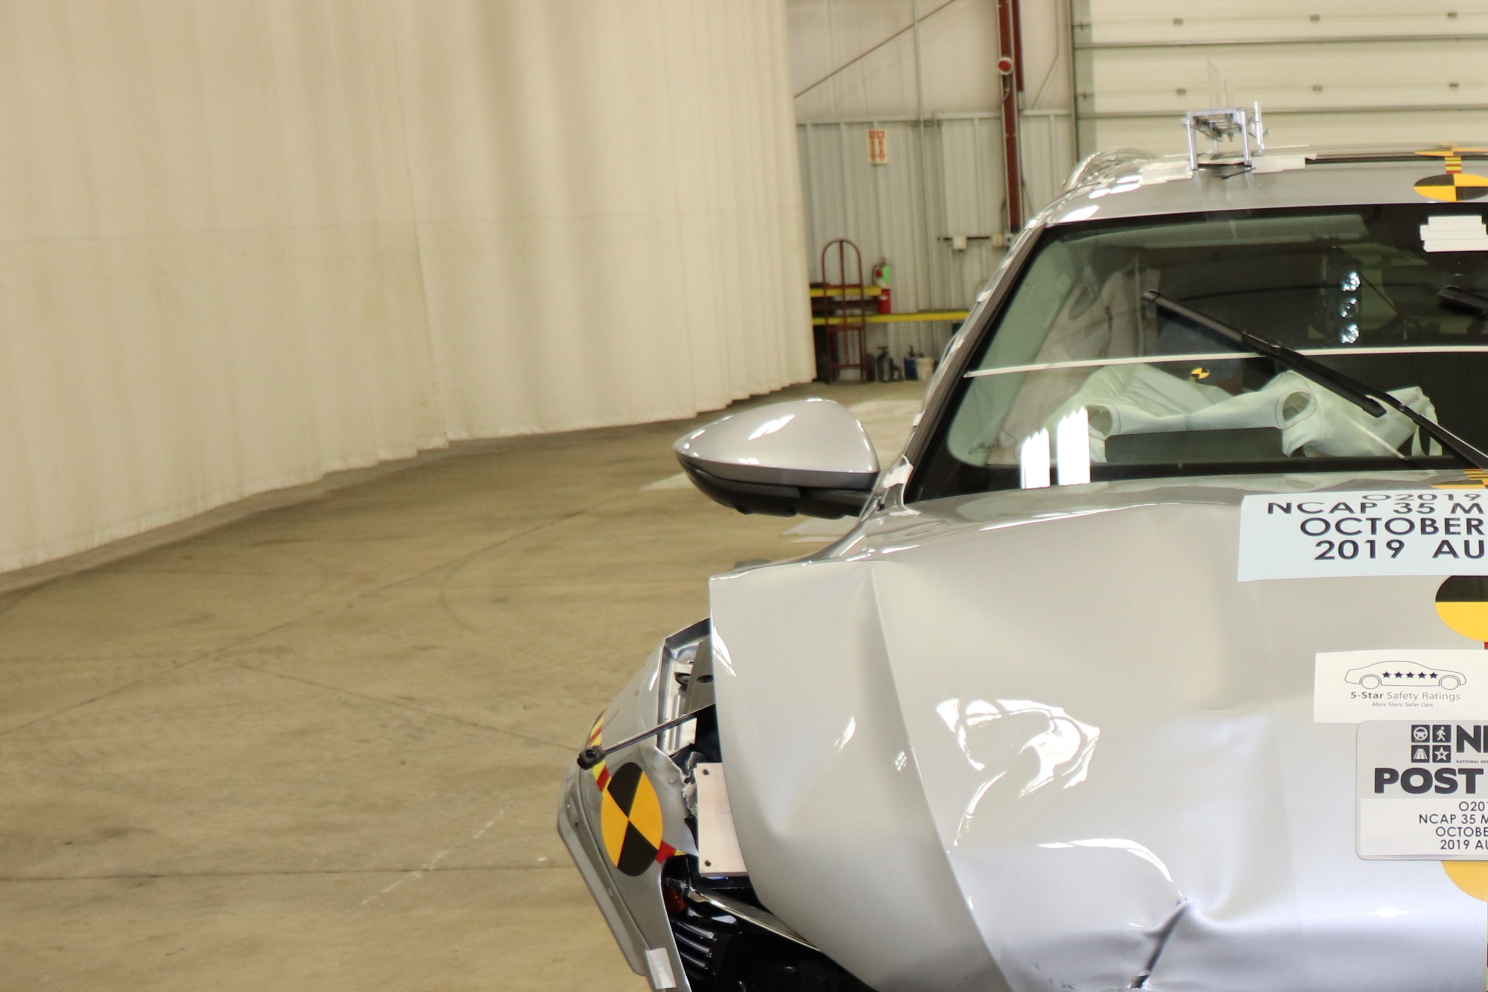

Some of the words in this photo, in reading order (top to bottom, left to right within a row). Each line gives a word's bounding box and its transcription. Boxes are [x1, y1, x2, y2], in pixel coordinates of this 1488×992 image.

[1267, 502, 1378, 514] NCAP
[1392, 502, 1436, 514] 35
[1300, 517, 1485, 536] OCTOBER
[1314, 539, 1405, 560] 2019
[1350, 691, 1384, 700] 5-Star
[1386, 691, 1419, 701] Safety
[1422, 691, 1461, 702] Ratings
[1374, 767, 1484, 794] POST
[1419, 814, 1457, 824] NCAP
[1461, 814, 1476, 824] 35
[1439, 839, 1471, 850] 2019
